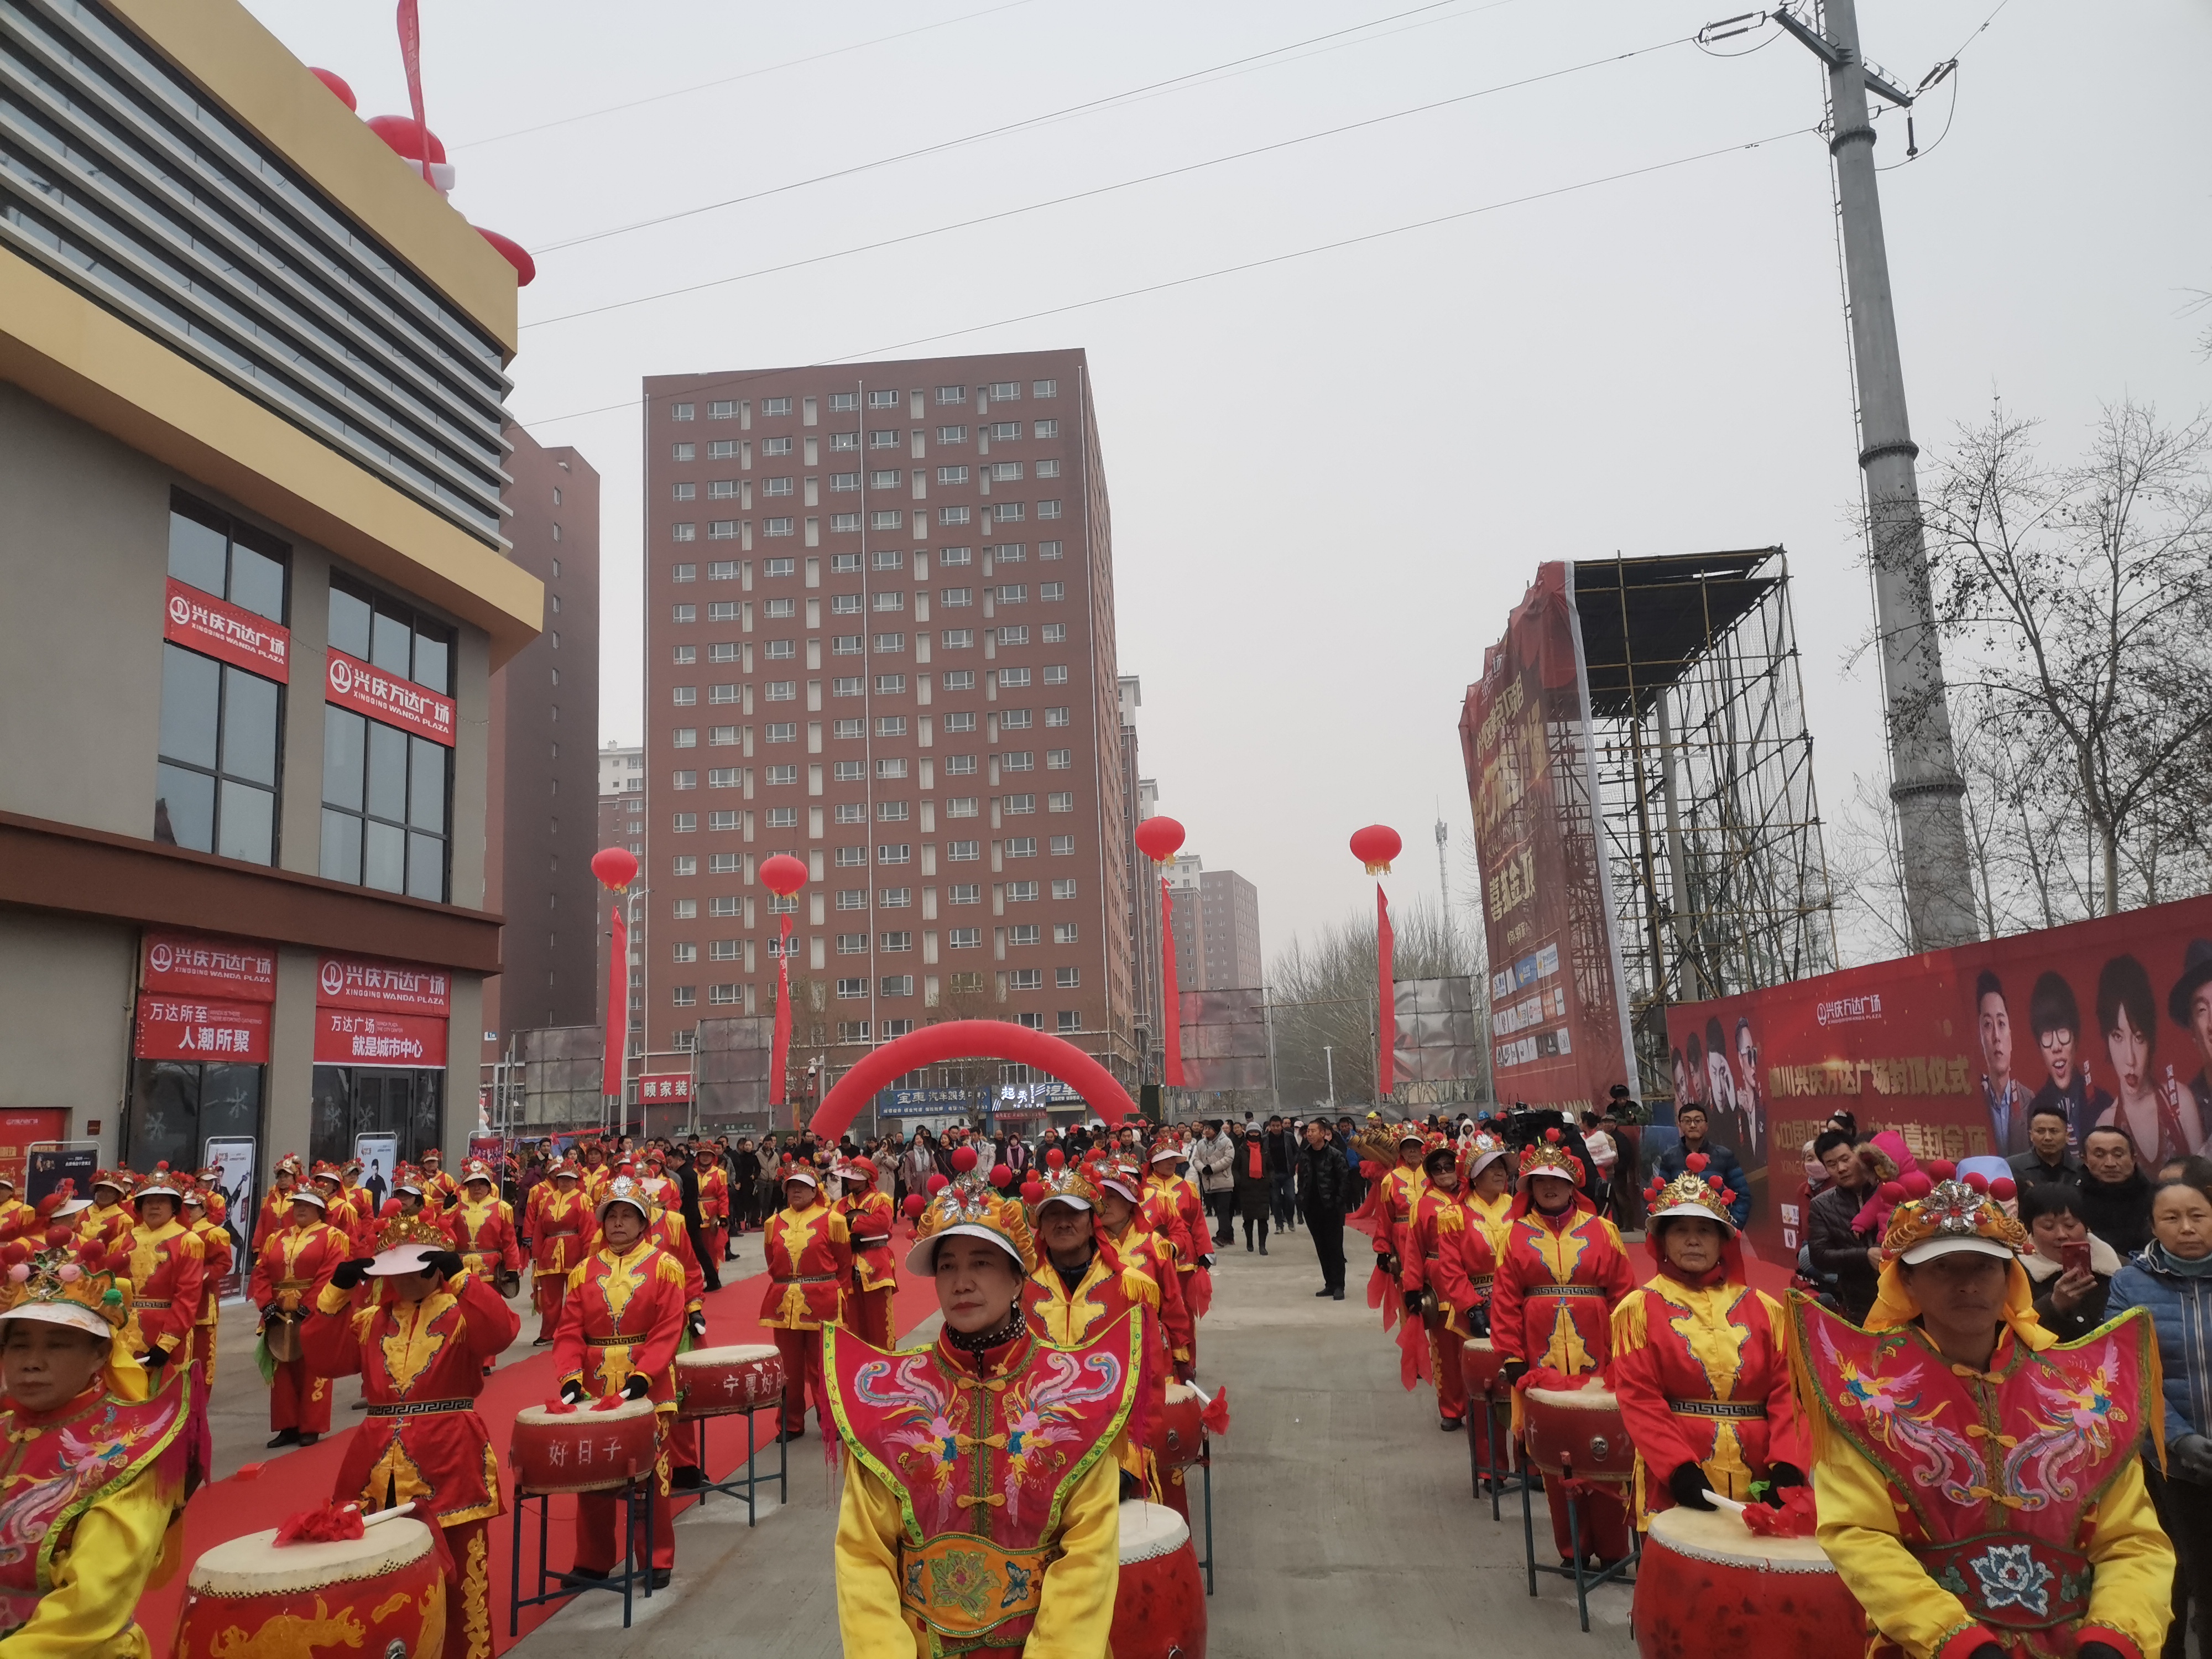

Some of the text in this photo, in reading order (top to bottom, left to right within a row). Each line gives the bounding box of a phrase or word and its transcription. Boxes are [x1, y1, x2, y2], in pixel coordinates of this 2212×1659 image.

[191, 604, 285, 657] 兴庆万达广场
[191, 622, 285, 665] XINGQING WANDA PLAZA
[354, 668, 450, 725] 兴庆万达广场
[353, 690, 450, 734] XINGQING WANDA PLAZA
[175, 947, 271, 974] 兴庆万达广场
[174, 966, 271, 983] XINGQING WANDA PLAZA
[346, 964, 445, 995] 兴庆万达广场
[346, 988, 445, 1005] XINGQING WANDA PLAZA
[1825, 994, 1881, 1019] 兴庆万达广场
[149, 1003, 208, 1023] 万达所至
[331, 1015, 375, 1034] 万达广场
[178, 1025, 249, 1052] 人潮所聚
[352, 1035, 423, 1058] 就是城市中心
[644, 1080, 697, 1098] 顾家装
[549, 1436, 622, 1467] 好日子
